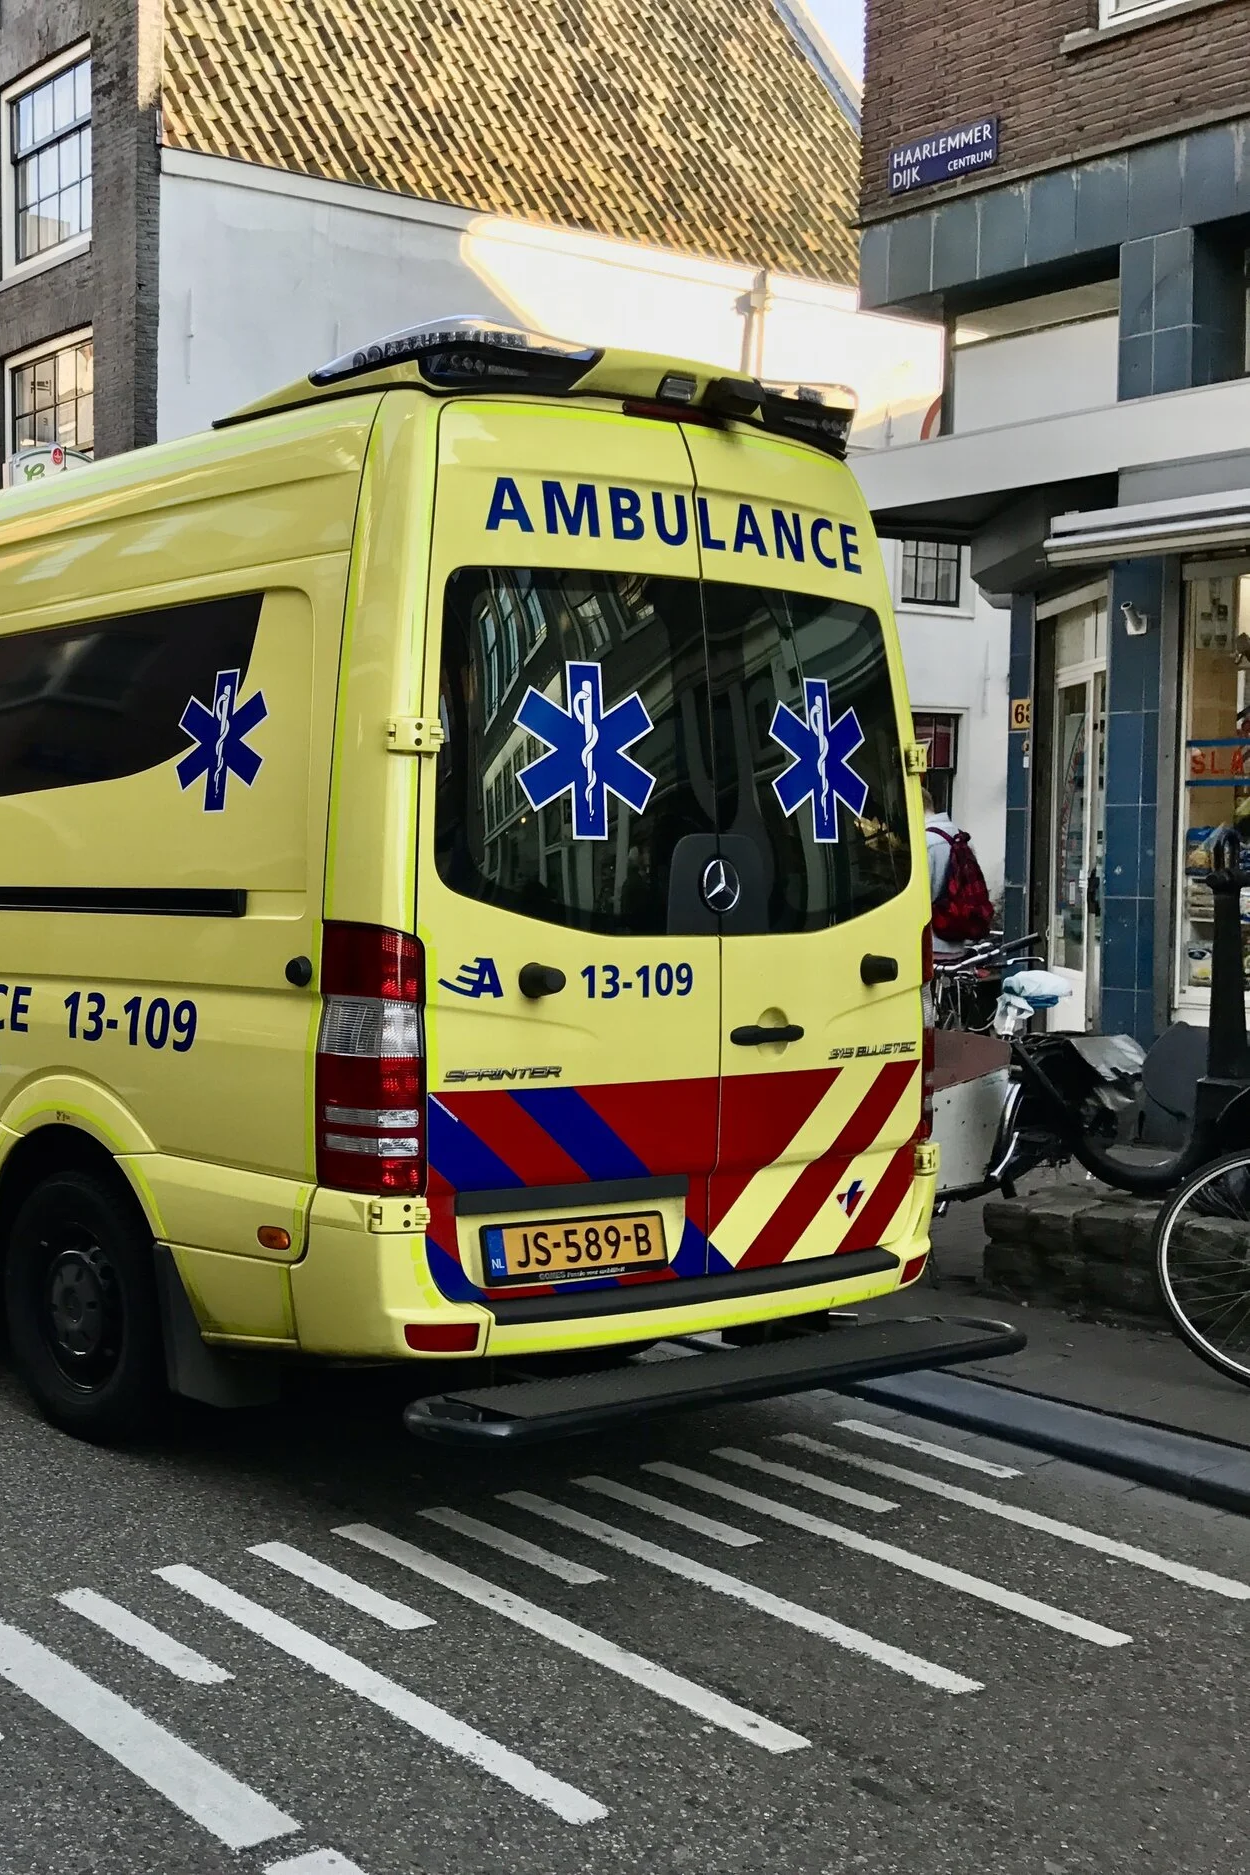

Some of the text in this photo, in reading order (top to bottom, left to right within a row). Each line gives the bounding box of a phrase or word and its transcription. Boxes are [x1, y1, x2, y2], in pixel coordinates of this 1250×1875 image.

[893, 124, 993, 169] HAARLEMMER
[892, 149, 993, 190] DIJK CENTRUM
[485, 476, 863, 575] AMBULANCE
[580, 962, 694, 999] 13-109
[63, 990, 198, 1053] 13-109
[443, 1065, 562, 1083] SPRINTER
[491, 1223, 652, 1270] NL JS-589-B
